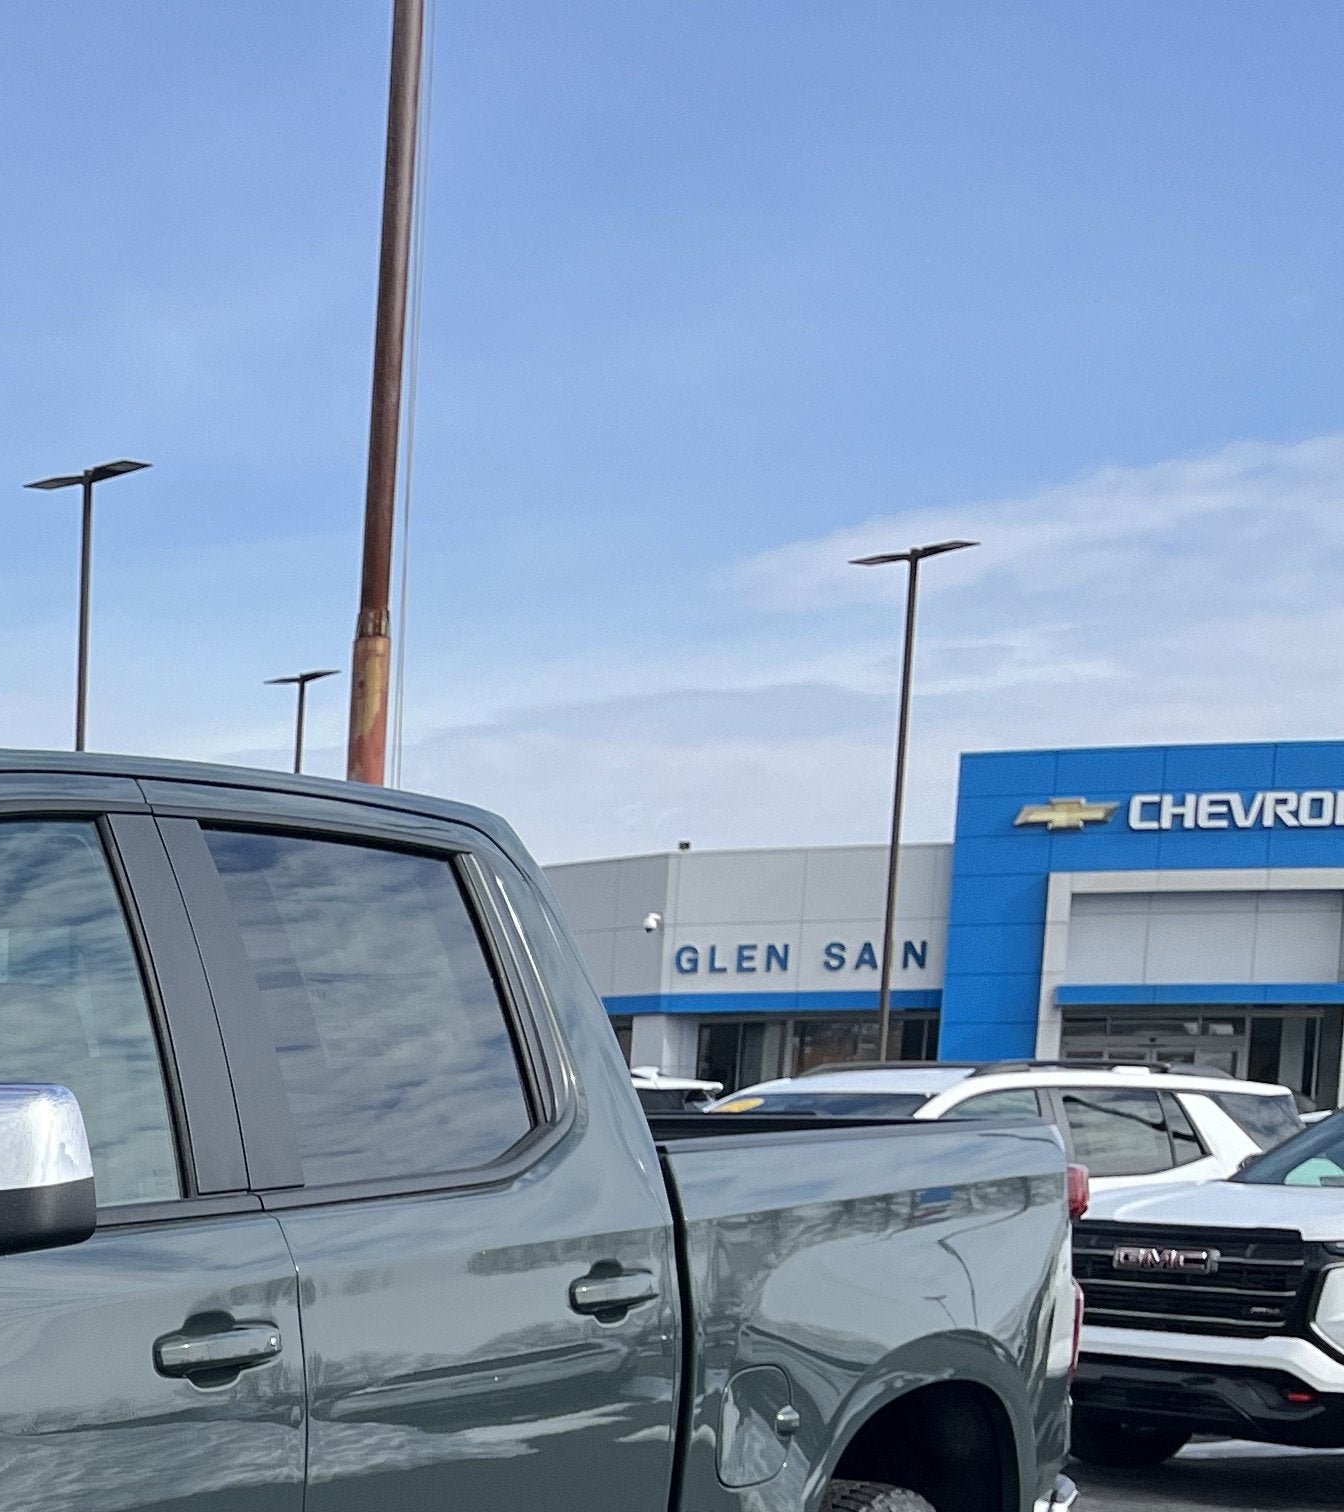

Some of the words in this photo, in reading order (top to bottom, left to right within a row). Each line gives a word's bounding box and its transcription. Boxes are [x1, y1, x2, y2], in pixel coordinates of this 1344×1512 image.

[674, 943, 790, 974] GLEN
[823, 940, 928, 971] SAN
[1114, 1247, 1216, 1274] GMC
